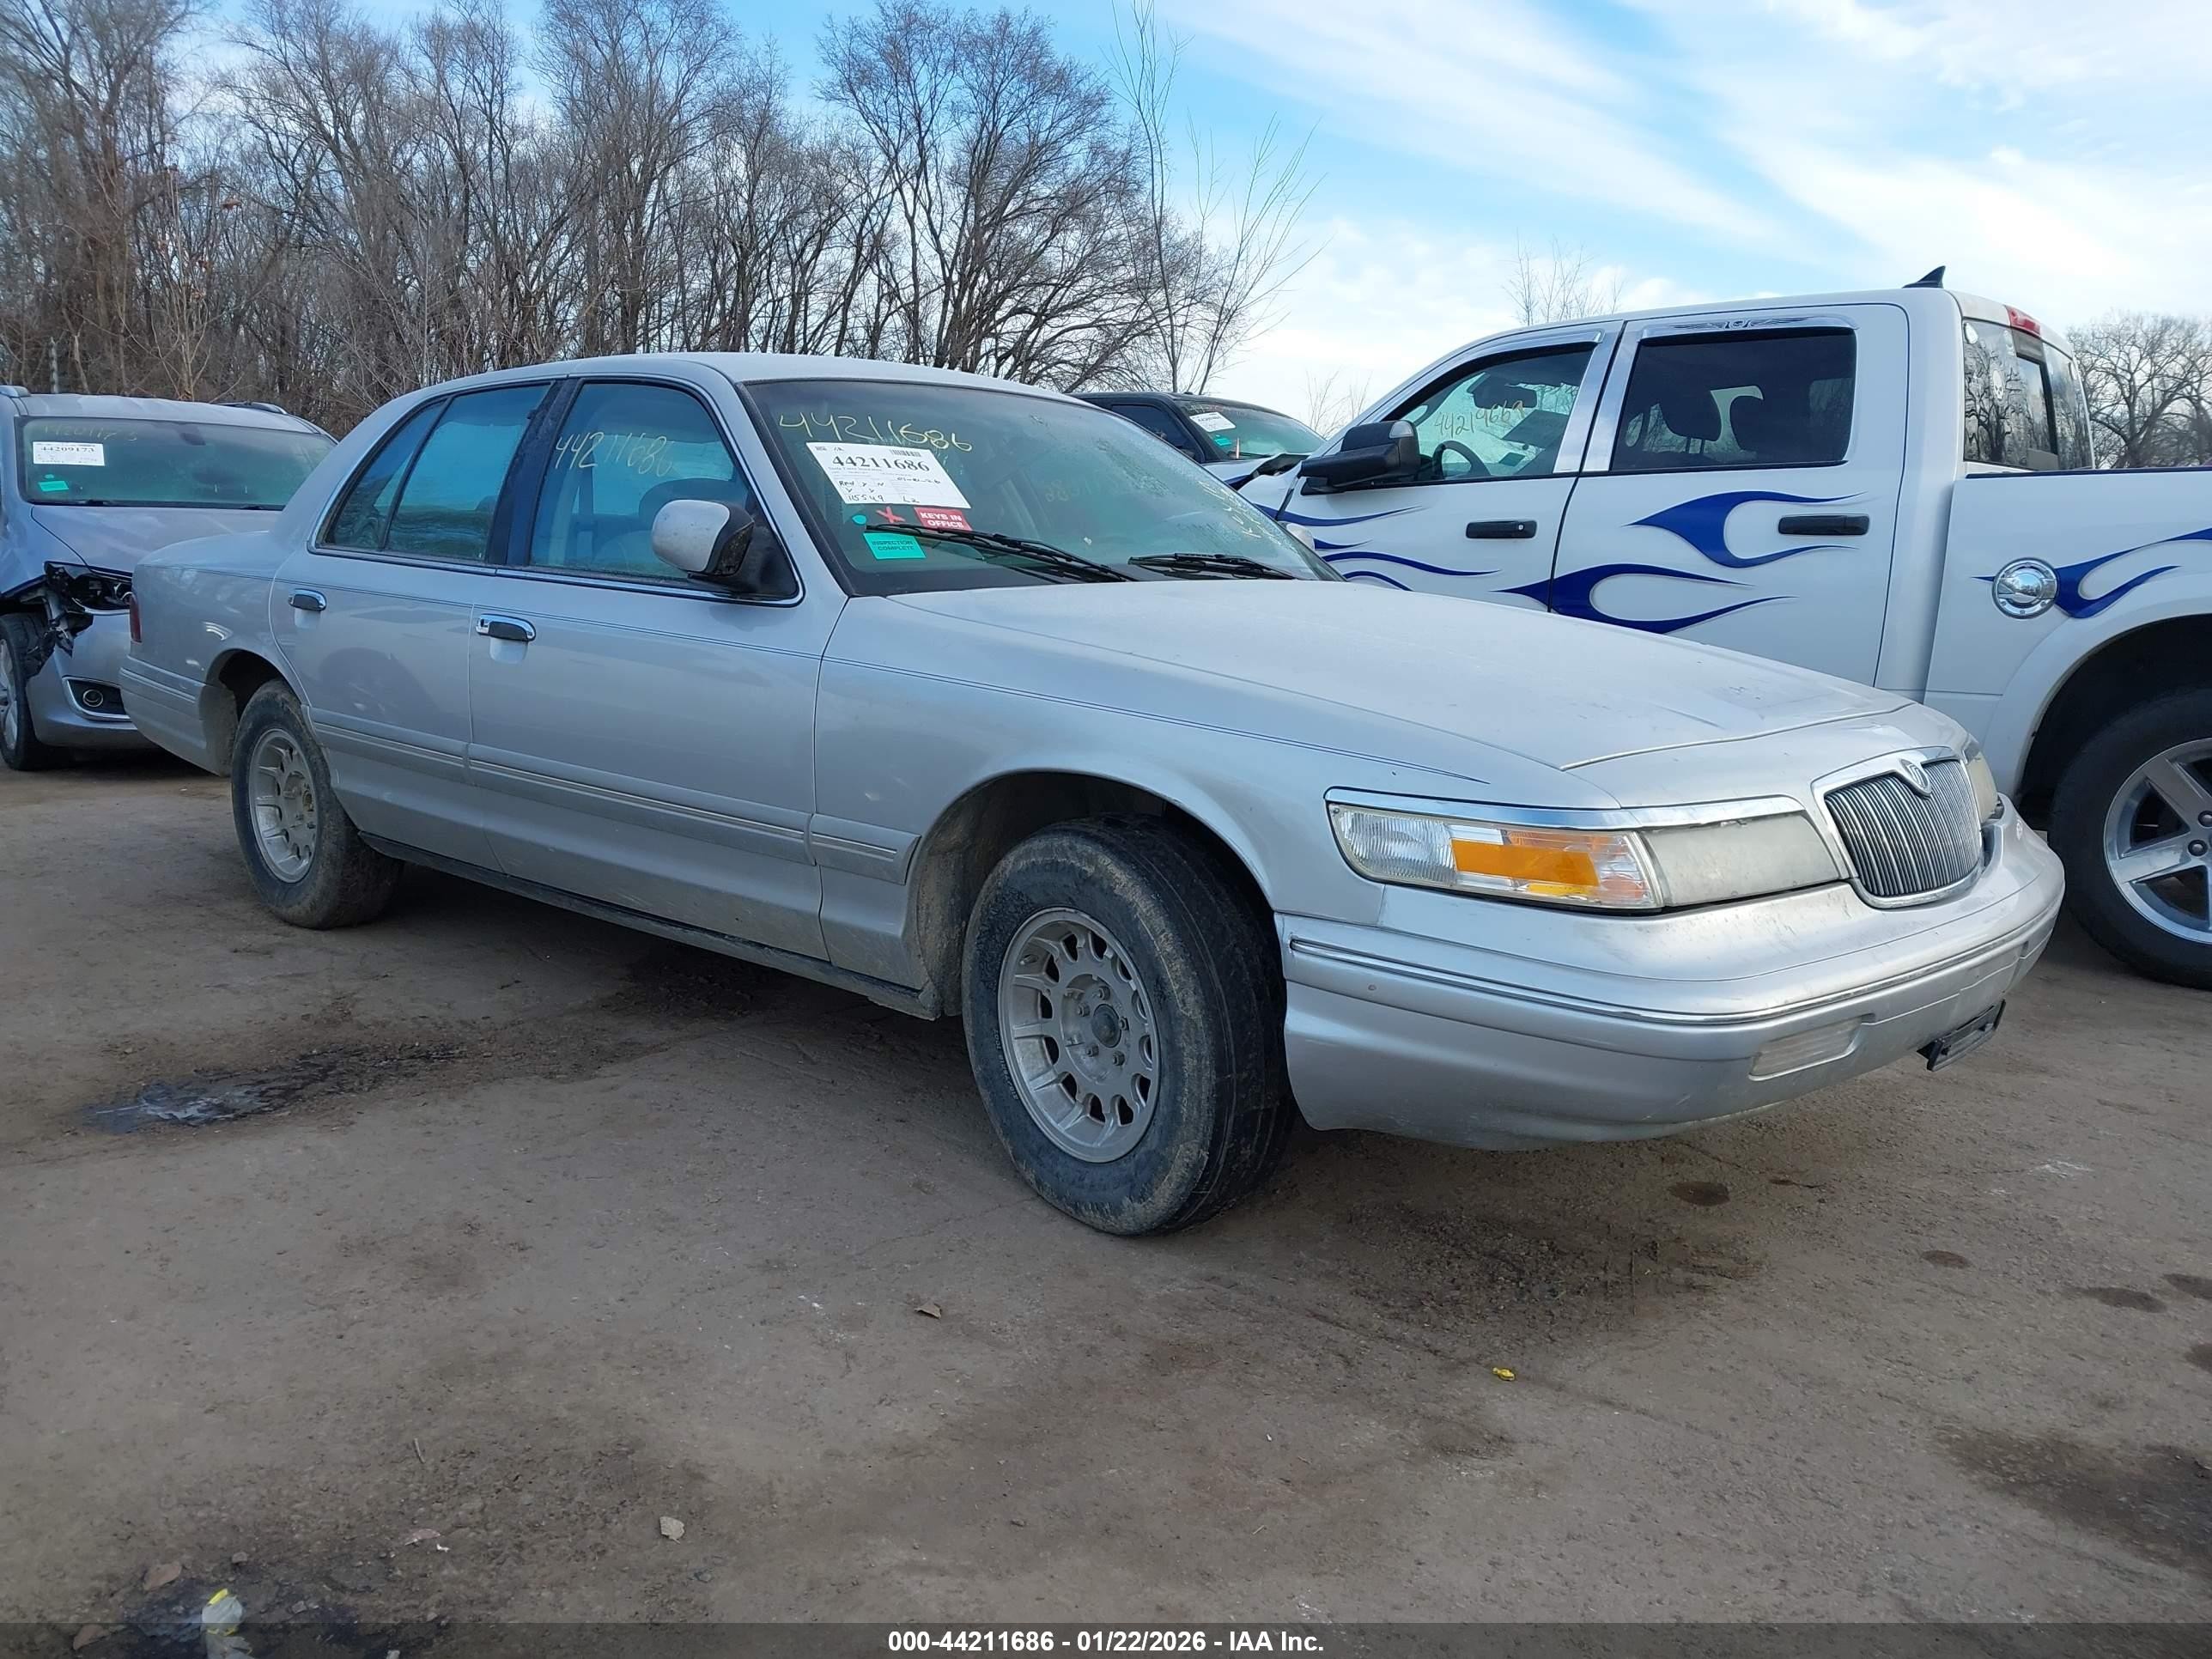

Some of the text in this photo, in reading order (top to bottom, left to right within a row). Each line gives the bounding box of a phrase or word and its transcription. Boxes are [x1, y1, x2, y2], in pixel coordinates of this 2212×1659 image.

[779, 412, 973, 452] 44211686
[832, 456, 930, 471] 44211686
[920, 512, 949, 520] KEYS
[927, 520, 964, 528] OFFICE
